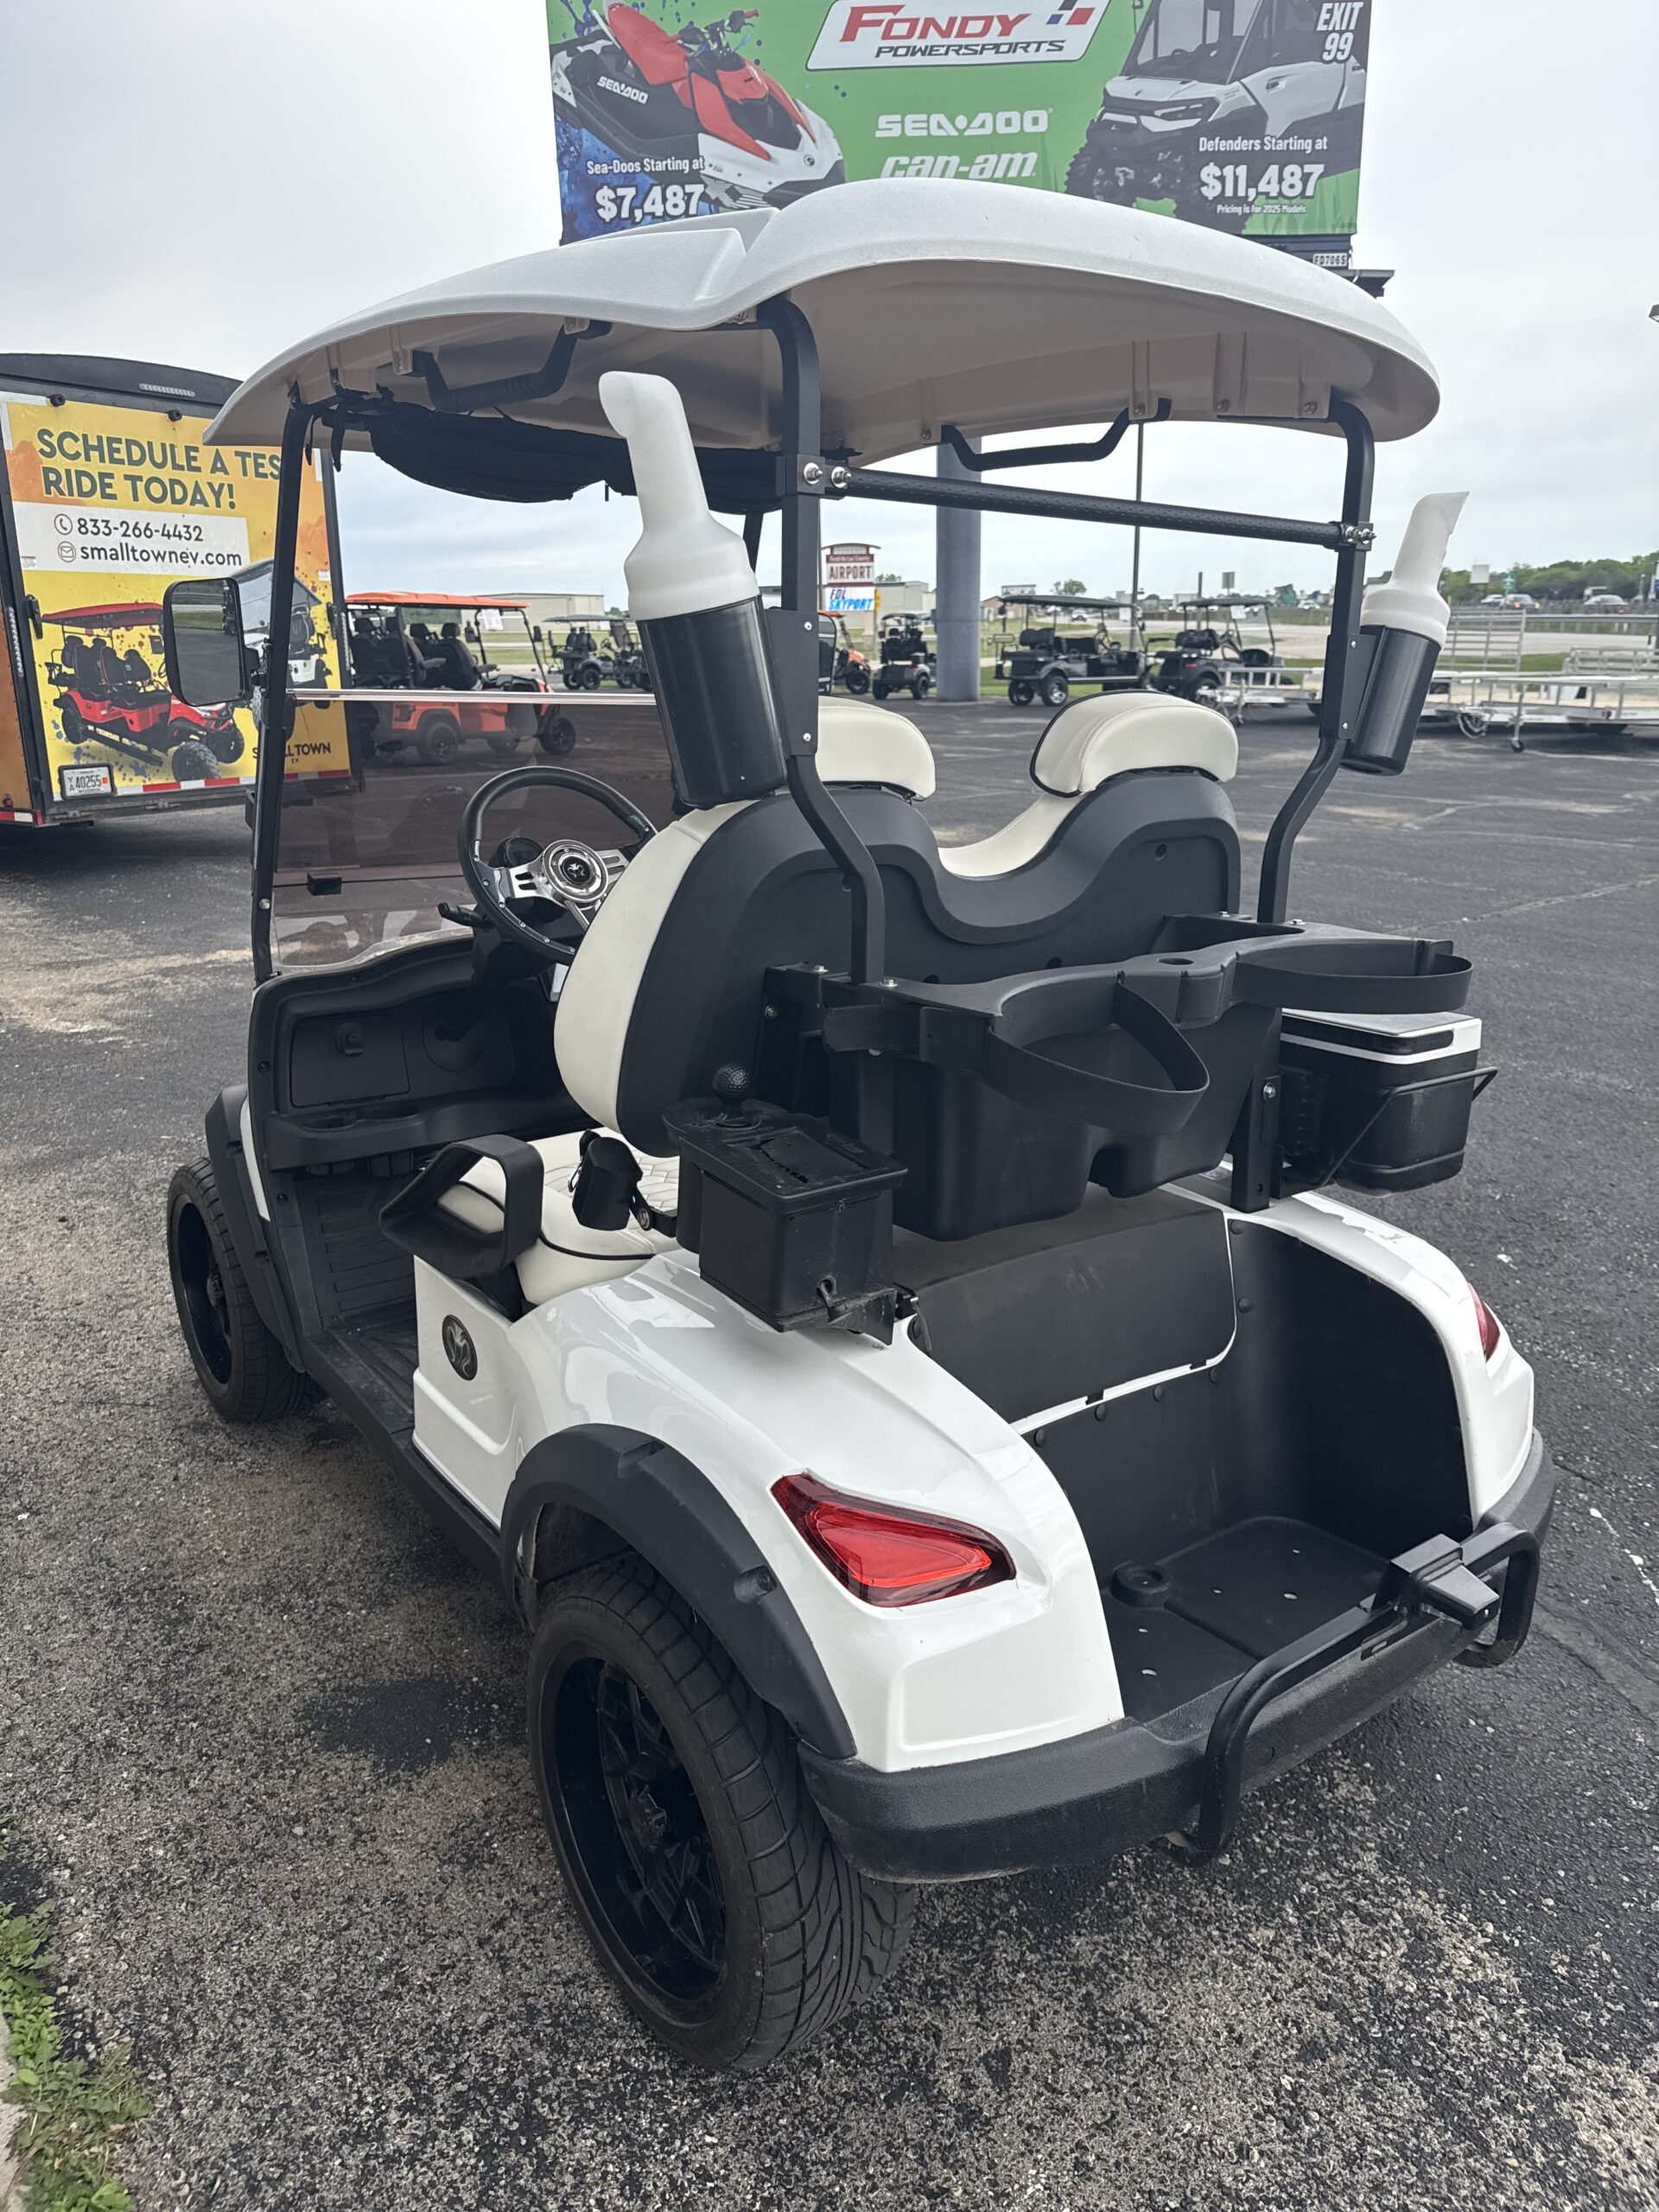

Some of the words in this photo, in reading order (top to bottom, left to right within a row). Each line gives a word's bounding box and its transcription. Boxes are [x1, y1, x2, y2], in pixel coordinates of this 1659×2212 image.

[839, 4, 1032, 42] FONDY
[1316, 2, 1364, 31] EXIT
[874, 40, 1067, 59] POWERSPORTS
[1322, 31, 1354, 61] 99
[1198, 137, 1262, 152] Defenders
[1263, 136, 1313, 155] Starting
[1314, 136, 1328, 150] at
[587, 160, 641, 175] Sea-Doos
[643, 156, 690, 174] Starting
[692, 156, 705, 170] at
[1199, 162, 1325, 202] $11,487
[595, 183, 705, 223] $7,487
[1216, 204, 1243, 216] Pricing
[1243, 204, 1250, 213] is
[36, 428, 202, 473] SCHEDULE
[209, 448, 230, 476] A
[234, 449, 282, 481] TES
[41, 466, 118, 501] RIDE
[123, 473, 237, 511] TODAY!
[77, 518, 204, 543] 833-266-4432
[79, 542, 243, 567] smalltownev.com
[829, 565, 872, 580] AIRPORT
[829, 598, 874, 610] SKYPORT
[75, 774, 102, 789] 40255
